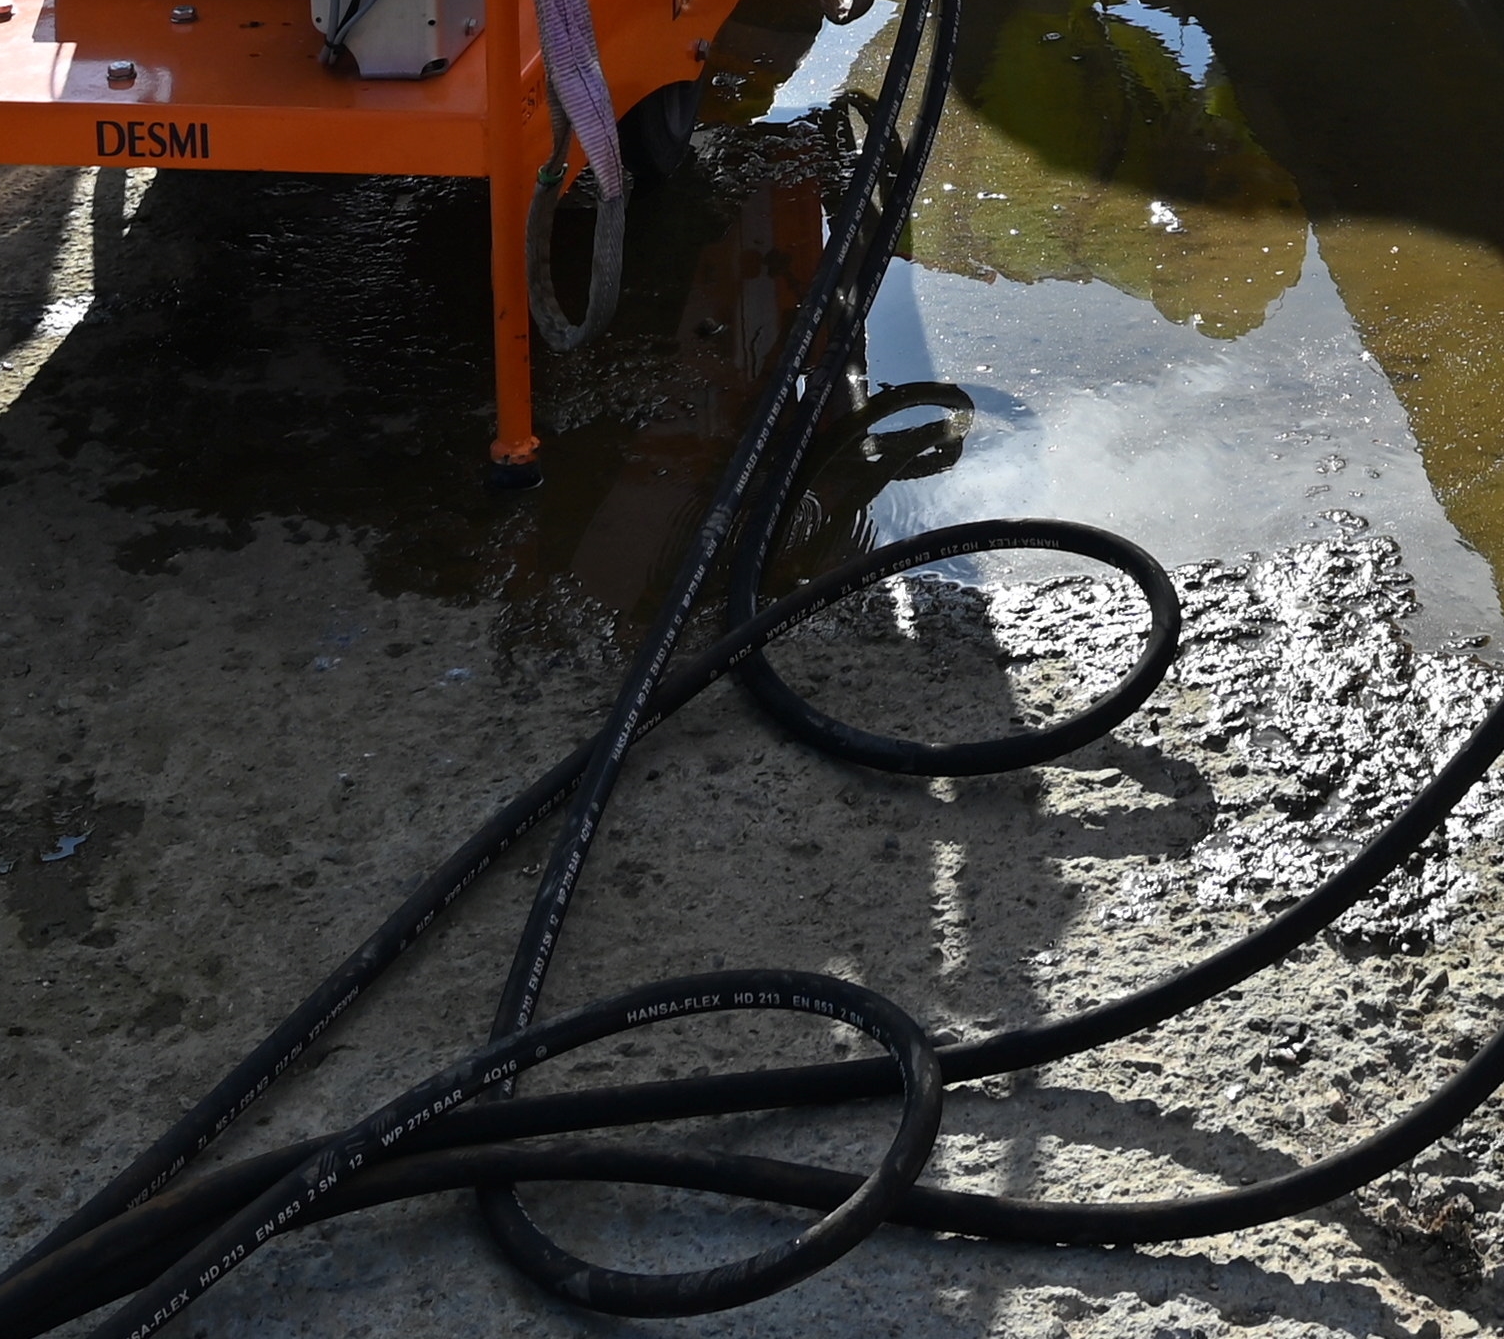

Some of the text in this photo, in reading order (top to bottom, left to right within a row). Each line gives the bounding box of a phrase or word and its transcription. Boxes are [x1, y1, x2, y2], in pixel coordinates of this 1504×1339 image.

[96, 119, 209, 160] DESMI
[626, 994, 719, 1022] HANSA-FLEX
[733, 991, 754, 1004] HD
[757, 991, 780, 1004] 213
[792, 994, 810, 1008] EN
[813, 998, 833, 1014] 853
[127, 1059, 517, 1339] SA-FLEX HD 213 EN 853 2 SN 12 WP 275 BAR 4Q16
